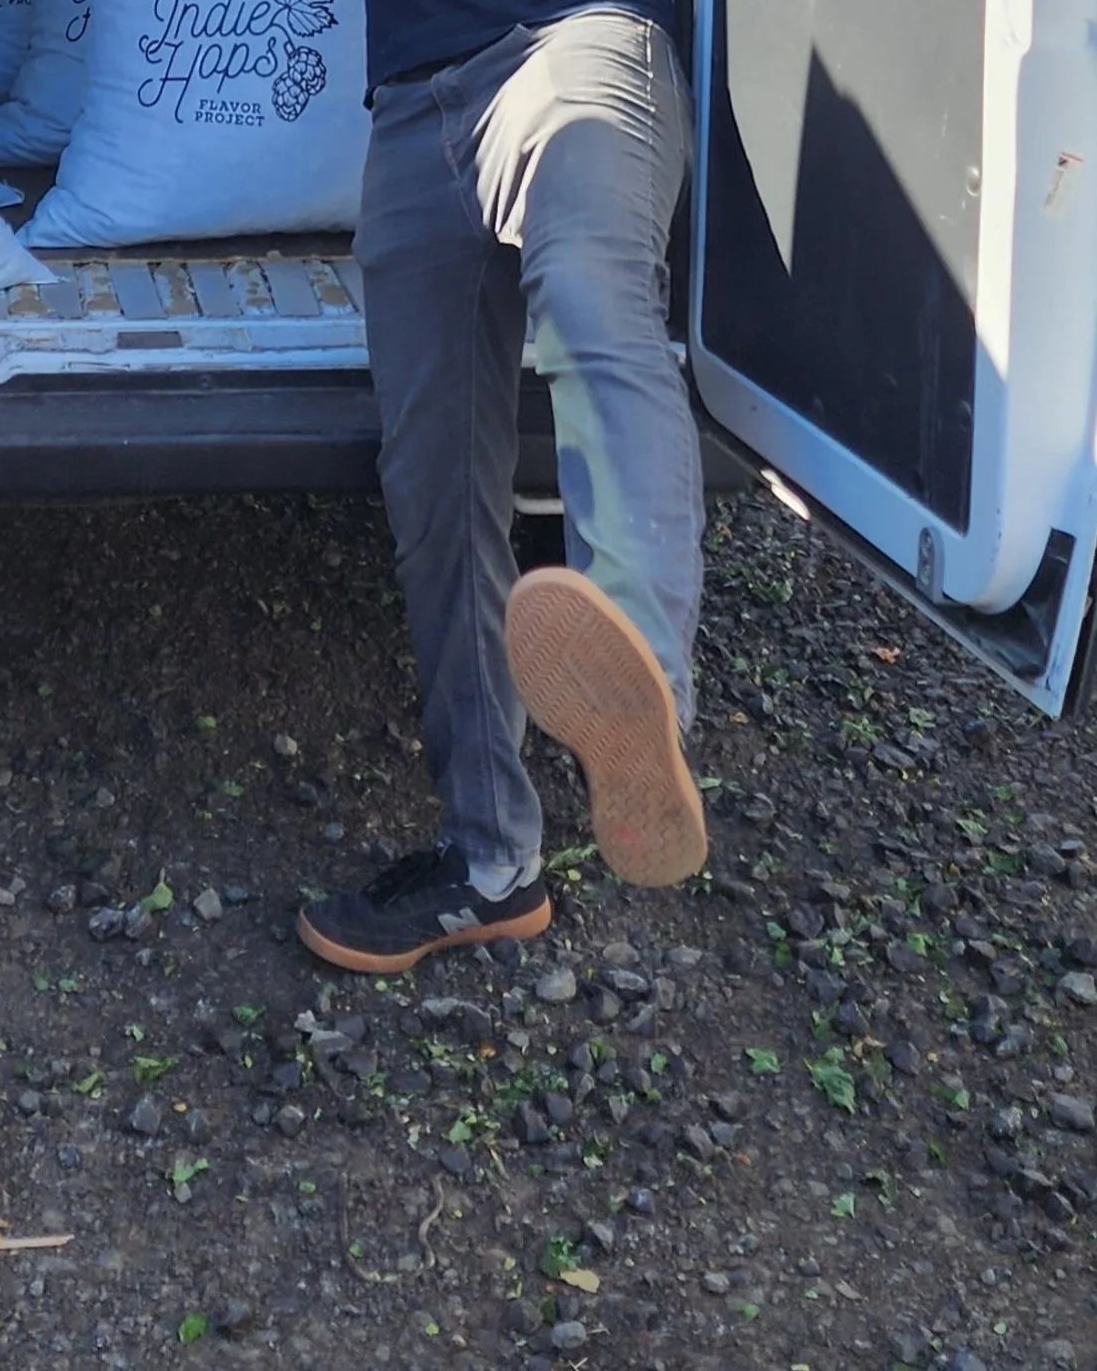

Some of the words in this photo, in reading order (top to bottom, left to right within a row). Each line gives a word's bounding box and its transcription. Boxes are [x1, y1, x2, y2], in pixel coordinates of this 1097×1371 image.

[137, 34, 279, 124] Hops
[198, 99, 262, 114] FLAVOR
[195, 111, 266, 127] PROJECT
